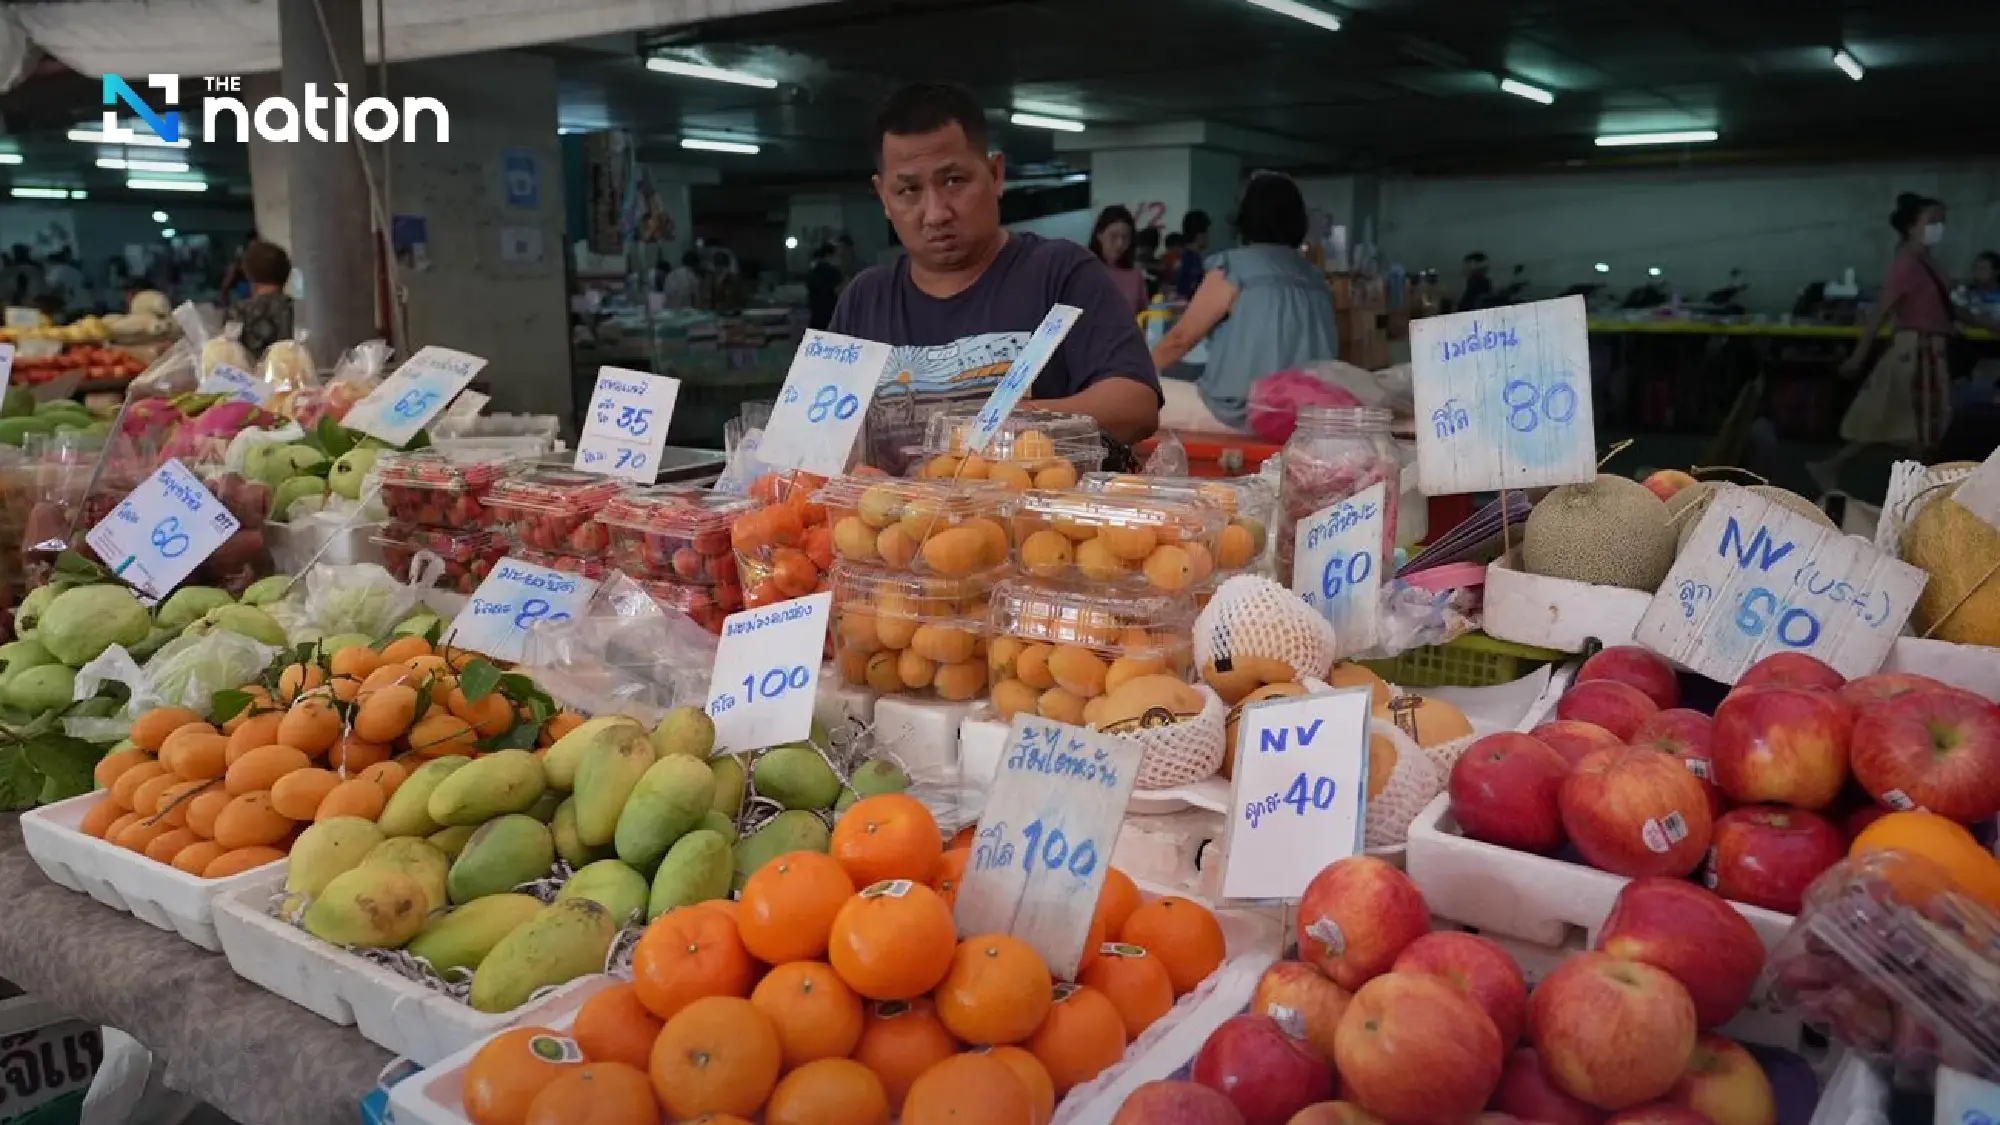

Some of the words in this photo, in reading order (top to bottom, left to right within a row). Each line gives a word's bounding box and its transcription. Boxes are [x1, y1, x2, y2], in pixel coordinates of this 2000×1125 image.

[616, 406, 653, 436] 35
[807, 385, 859, 423] 80
[1503, 379, 1579, 432] 80
[615, 448, 647, 468] 70
[151, 515, 190, 558] 60
[1718, 516, 1795, 572] NV
[1323, 551, 1372, 599] 60
[514, 599, 572, 630] 8
[1735, 587, 1821, 647] 60
[742, 666, 810, 703] 100
[1282, 772, 1336, 816] 40
[1023, 819, 1098, 877] 100
